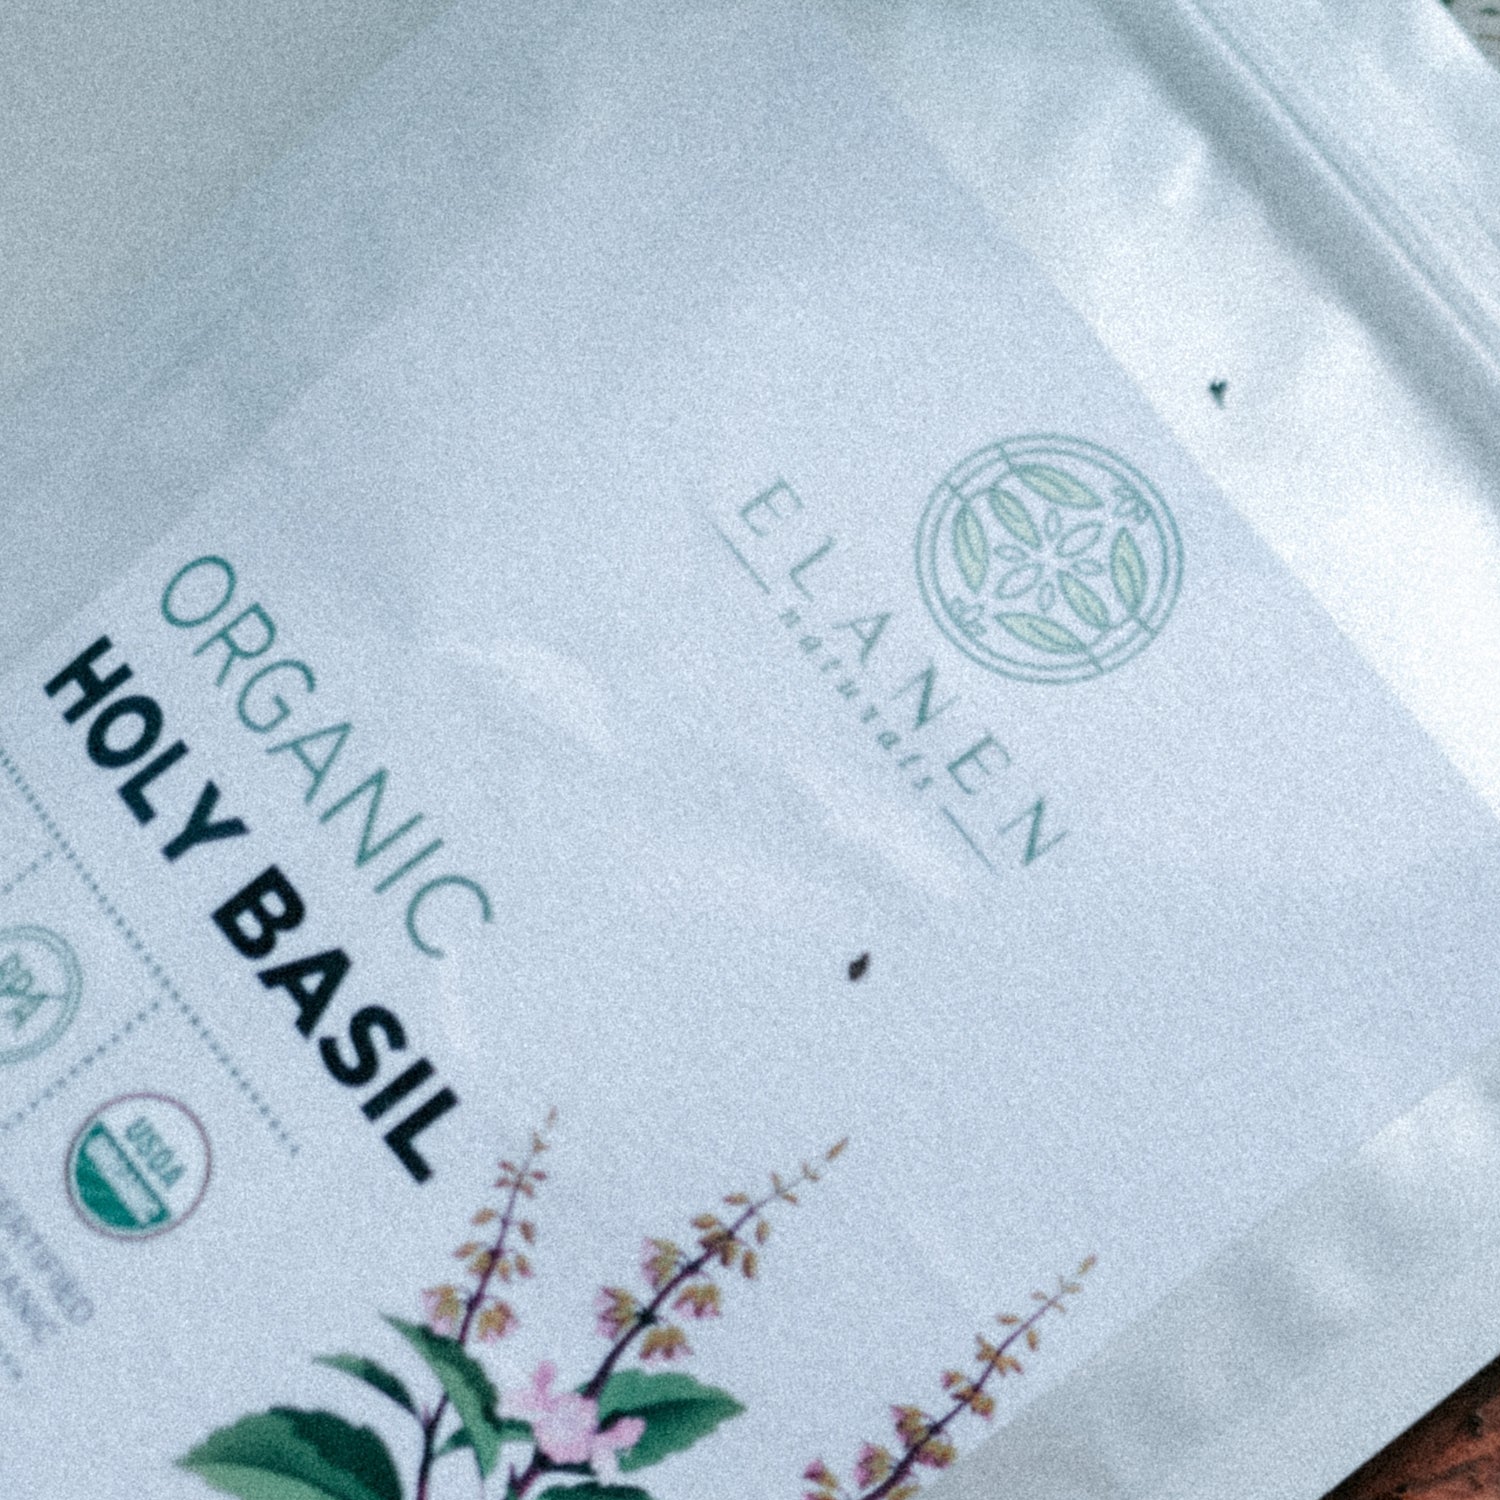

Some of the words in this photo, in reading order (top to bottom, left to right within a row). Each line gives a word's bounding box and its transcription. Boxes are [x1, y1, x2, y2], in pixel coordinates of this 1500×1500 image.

[160, 554, 494, 959] ORGANIC
[739, 477, 1070, 867] ELANEN
[779, 607, 935, 791] naturals
[43, 634, 252, 863] HOLY
[210, 863, 460, 1185] BASIL
